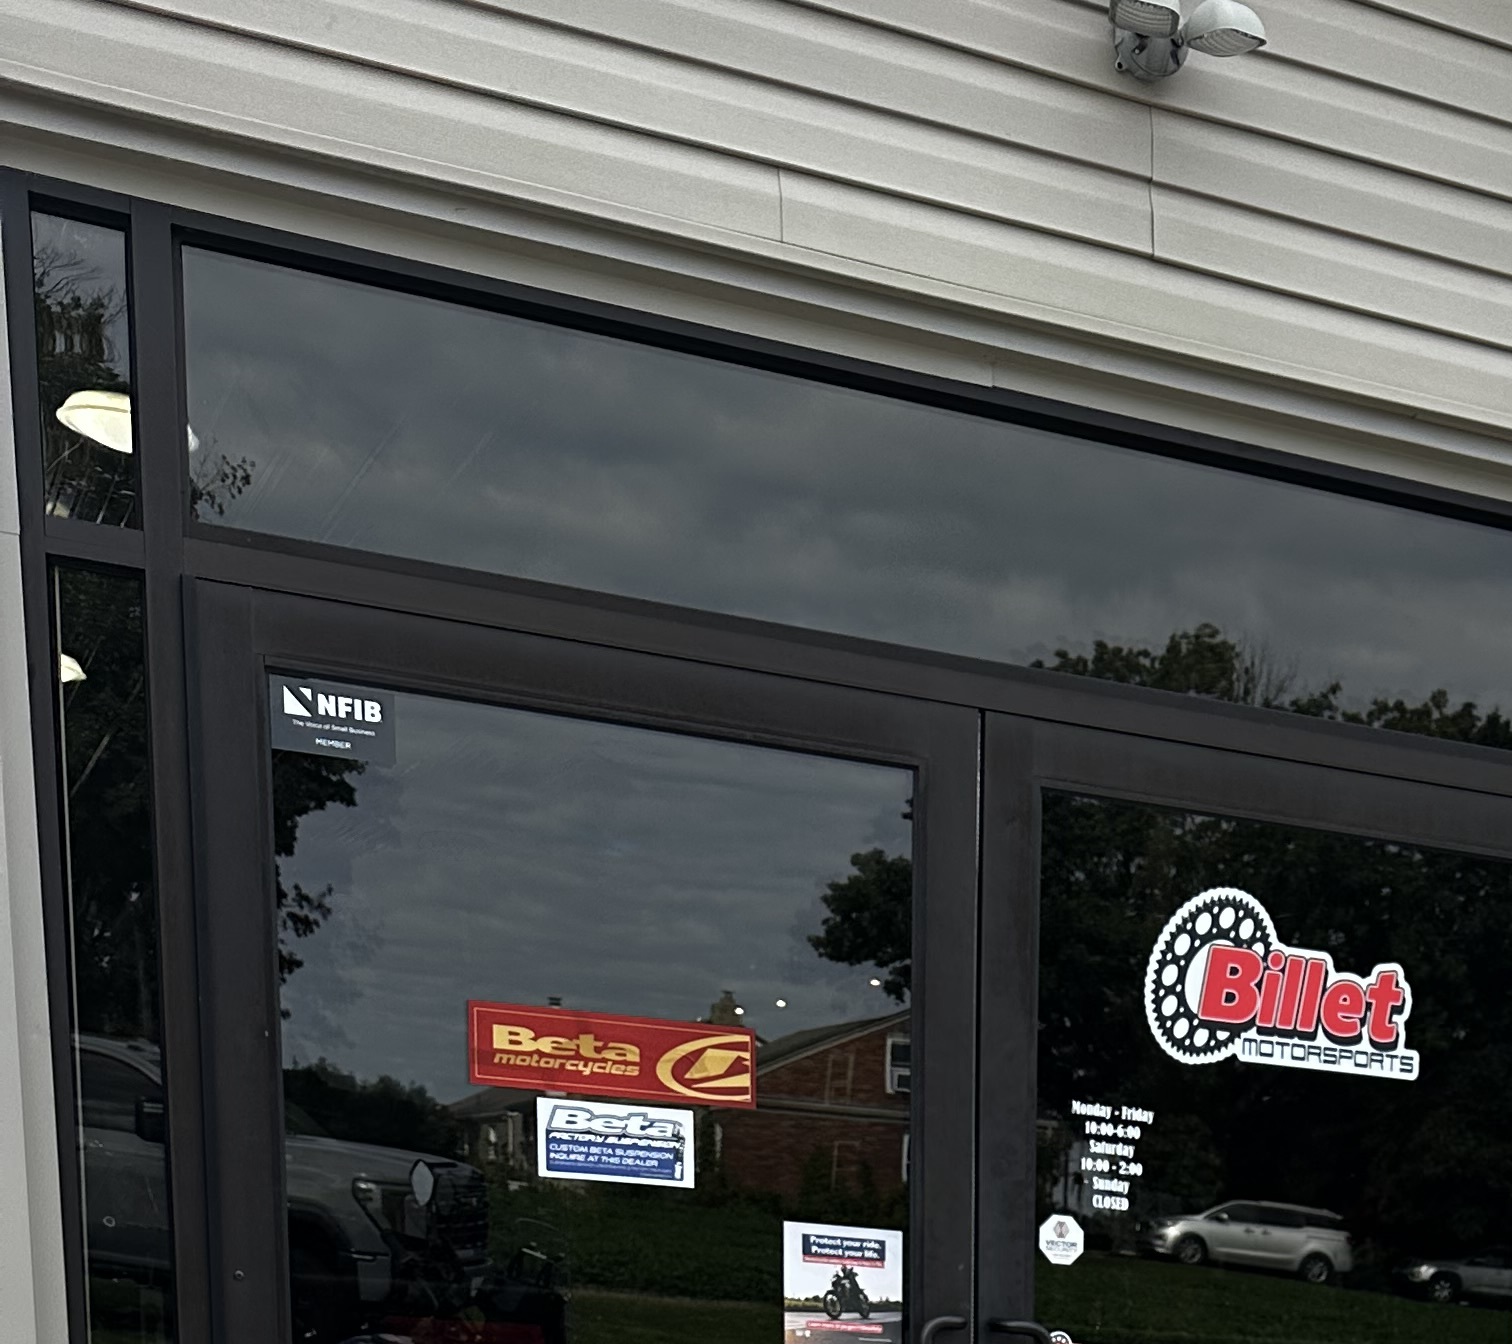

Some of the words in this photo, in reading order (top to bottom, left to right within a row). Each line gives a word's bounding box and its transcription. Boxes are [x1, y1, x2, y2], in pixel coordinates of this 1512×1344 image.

[317, 693, 382, 722] NFIB
[1198, 944, 1404, 1051] Billet
[492, 1024, 640, 1063] Beta
[493, 1052, 640, 1076] motorcycles
[1242, 1037, 1414, 1073] MOTORSPORTS
[1071, 1099, 1113, 1120] Monday
[1121, 1106, 1155, 1125] Friday
[546, 1105, 684, 1140] Beta
[1085, 1120, 1141, 1140] 10:00-6:00
[549, 1143, 588, 1154] CUSTOM
[589, 1146, 613, 1156] BETA
[614, 1148, 674, 1160] SUSPENSION
[1089, 1139, 1136, 1159] Saturday
[550, 1152, 585, 1162] INQUIRE
[587, 1155, 600, 1163] AT
[601, 1156, 620, 1165] THIS
[621, 1158, 659, 1168] DEALER
[1081, 1157, 1110, 1173] 10:00
[1118, 1161, 1143, 1177] 2:00
[1092, 1176, 1130, 1195] Sunday
[1092, 1194, 1129, 1211] CLOSED
[810, 1235, 842, 1247] Protect
[811, 1245, 843, 1256] Protect
